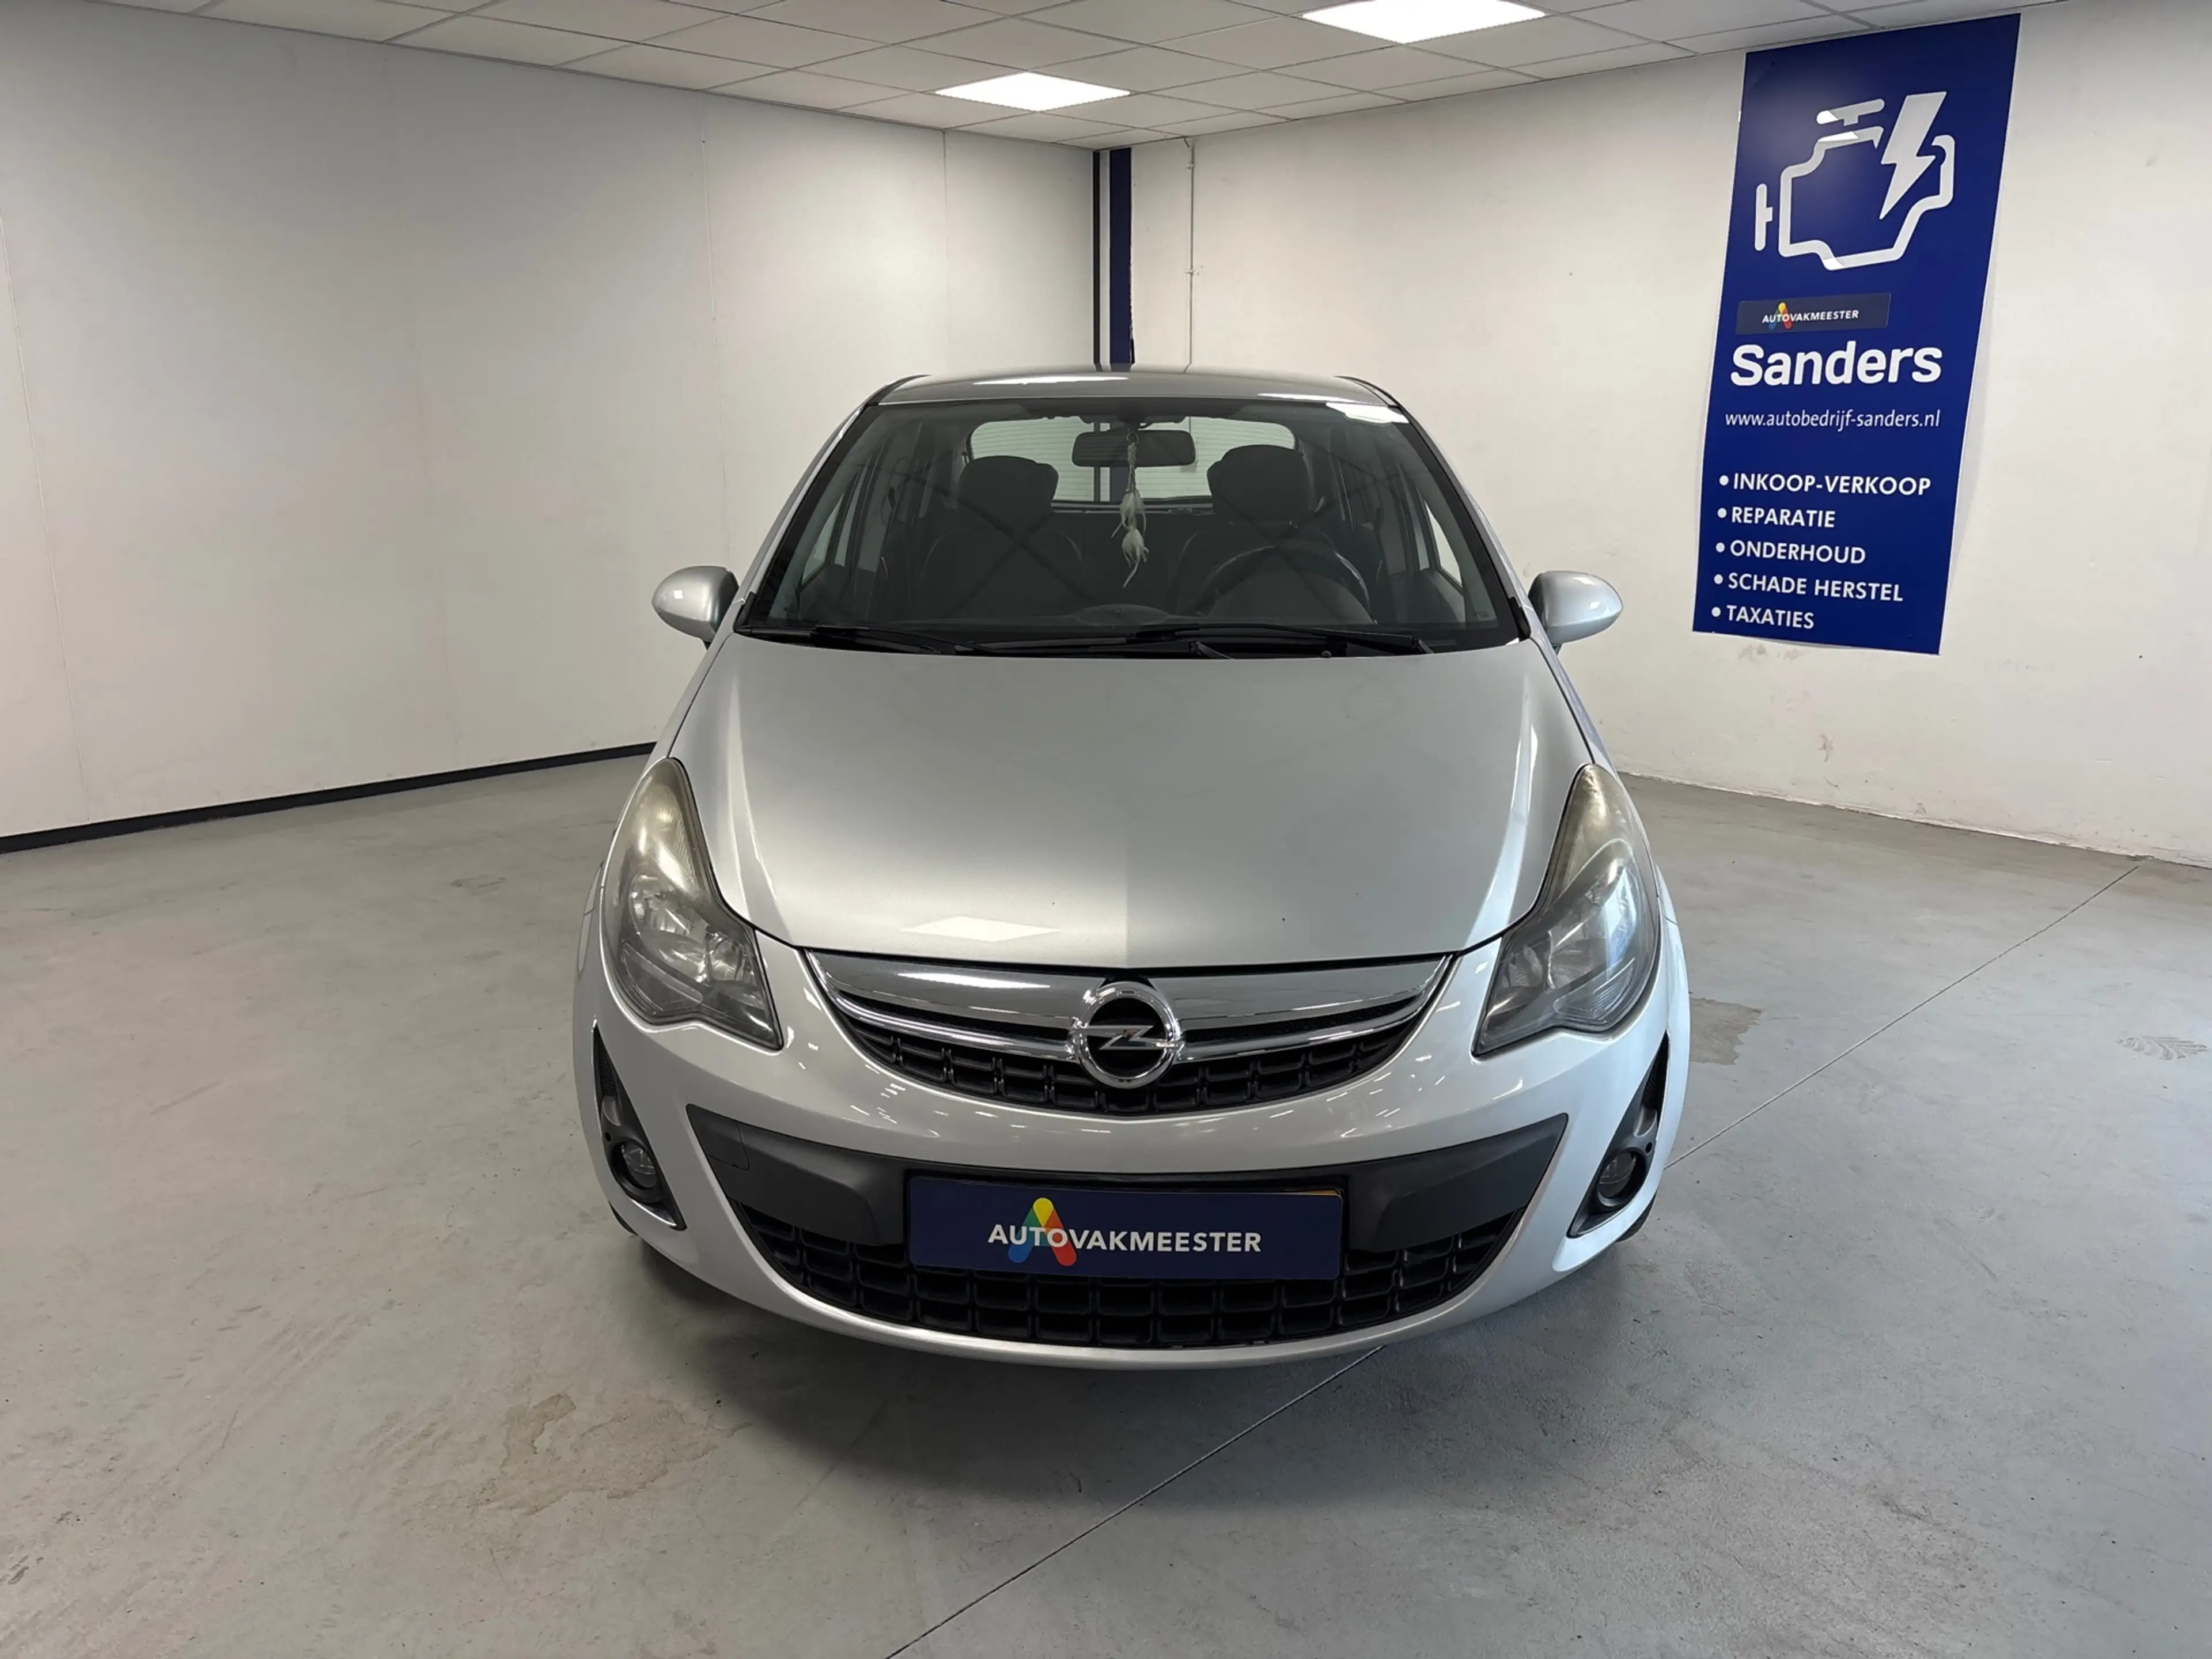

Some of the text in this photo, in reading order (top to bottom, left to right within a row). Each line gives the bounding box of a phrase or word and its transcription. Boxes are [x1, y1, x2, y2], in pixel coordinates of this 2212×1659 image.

[1762, 309, 1859, 324] AUTOVAKMEESTER
[1730, 341, 1942, 385] Sanders
[1725, 409, 1940, 432] www.autobedrijf-sanders.nl
[1733, 473, 1931, 495] INKOOP-VERKOOP
[1732, 506, 1836, 528] REPARATIE
[1730, 540, 1866, 564] ONDERHOUD
[1728, 573, 1903, 602] SCHADE HERSTEL
[1726, 605, 1815, 629] TAXATIES
[988, 1224, 1262, 1252] AUTOVAKMEESTER
